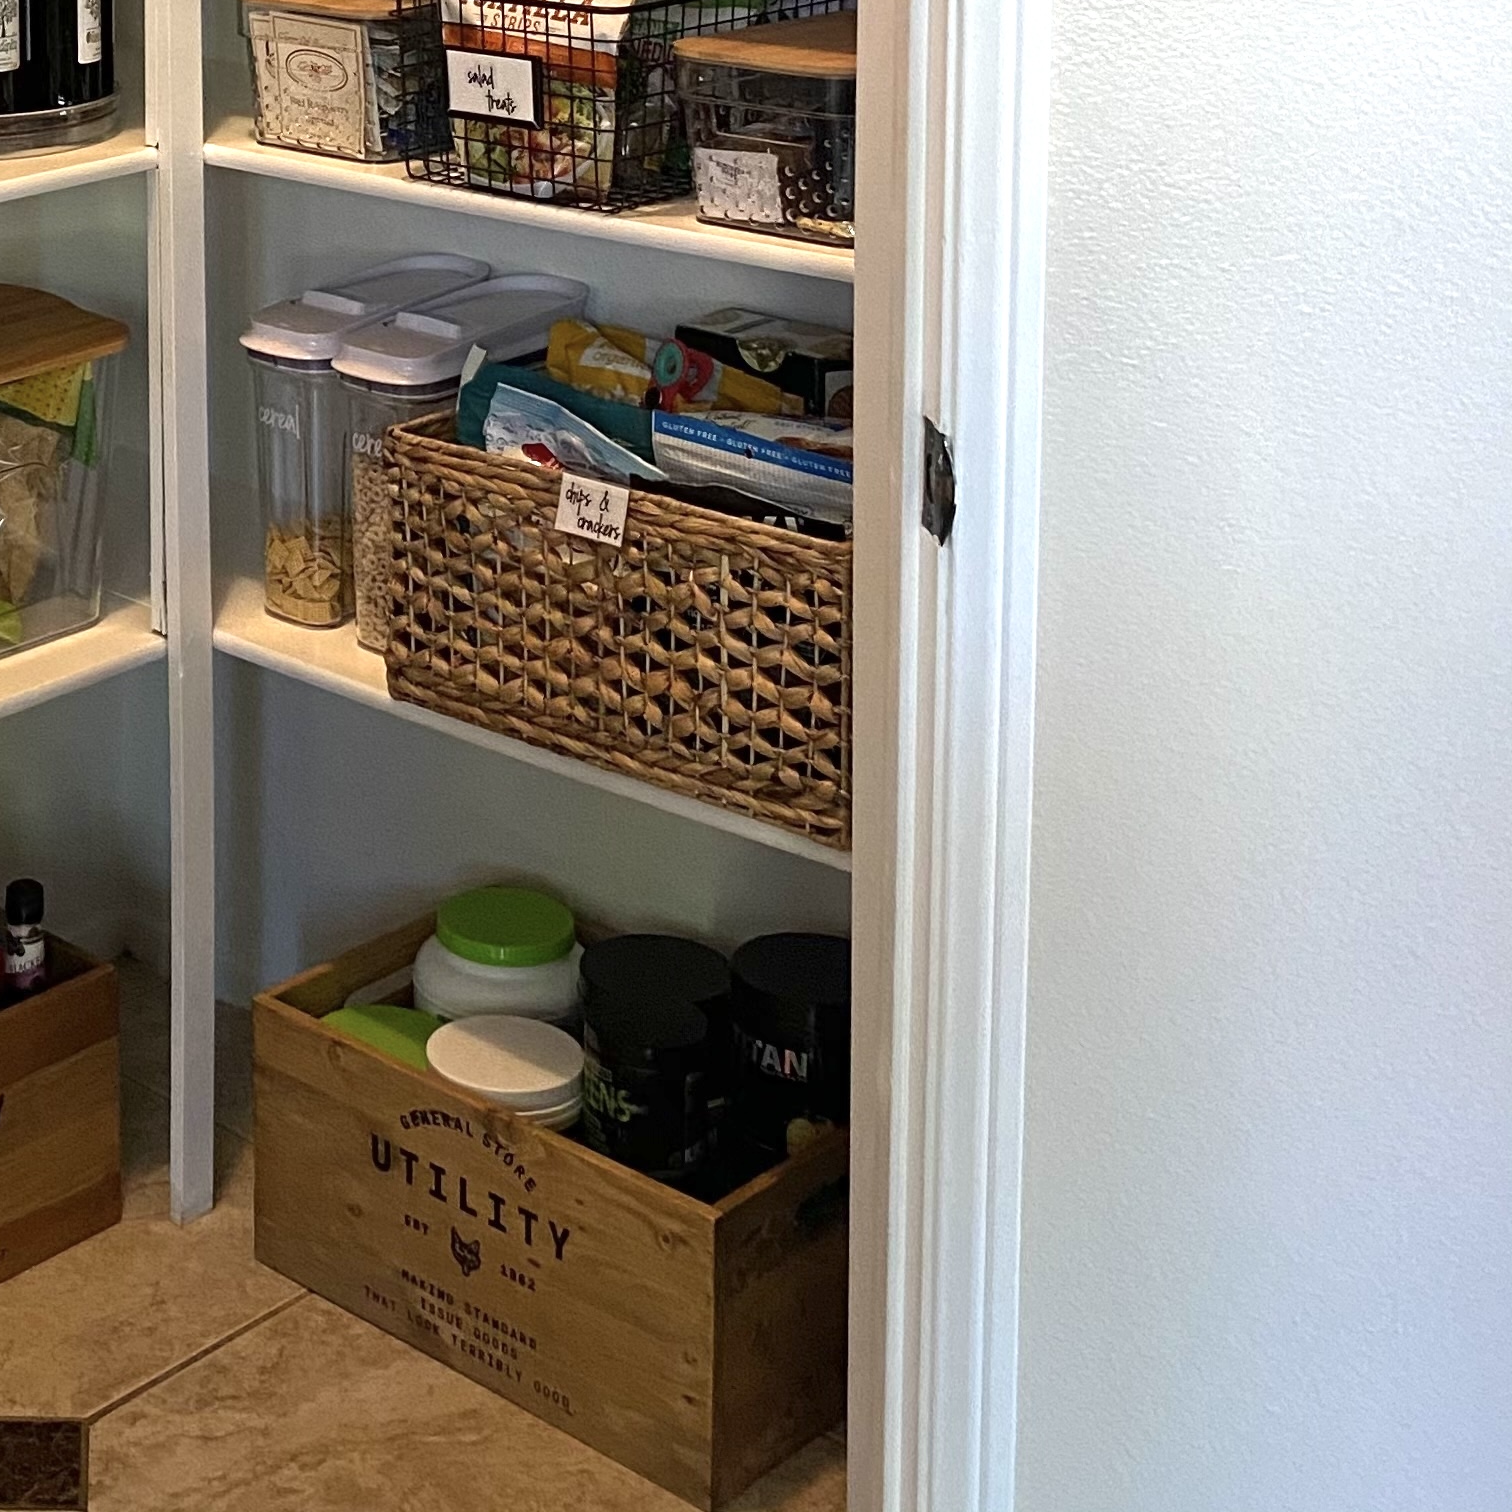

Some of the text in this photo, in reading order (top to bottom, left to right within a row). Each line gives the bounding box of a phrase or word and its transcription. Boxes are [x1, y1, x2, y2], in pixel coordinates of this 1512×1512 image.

[467, 64, 495, 90] salad
[485, 90, 517, 116] treats
[258, 404, 301, 440] cereal
[661, 420, 695, 436] GLUTEN
[696, 429, 718, 443] FREE
[725, 437, 759, 453] GLUTEN
[352, 431, 384, 458] cere
[565, 481, 610, 517] chips &
[577, 513, 622, 541] crackers
[399, 1108, 537, 1193] GENERAL STORE
[370, 1131, 571, 1261] UTILITY
[401, 1268, 537, 1351] MAKING STANDARD
[364, 1284, 396, 1312] THAT
[451, 1332, 523, 1384] TERRIBLY
[420, 1295, 519, 1361] ISSUE GOODS
